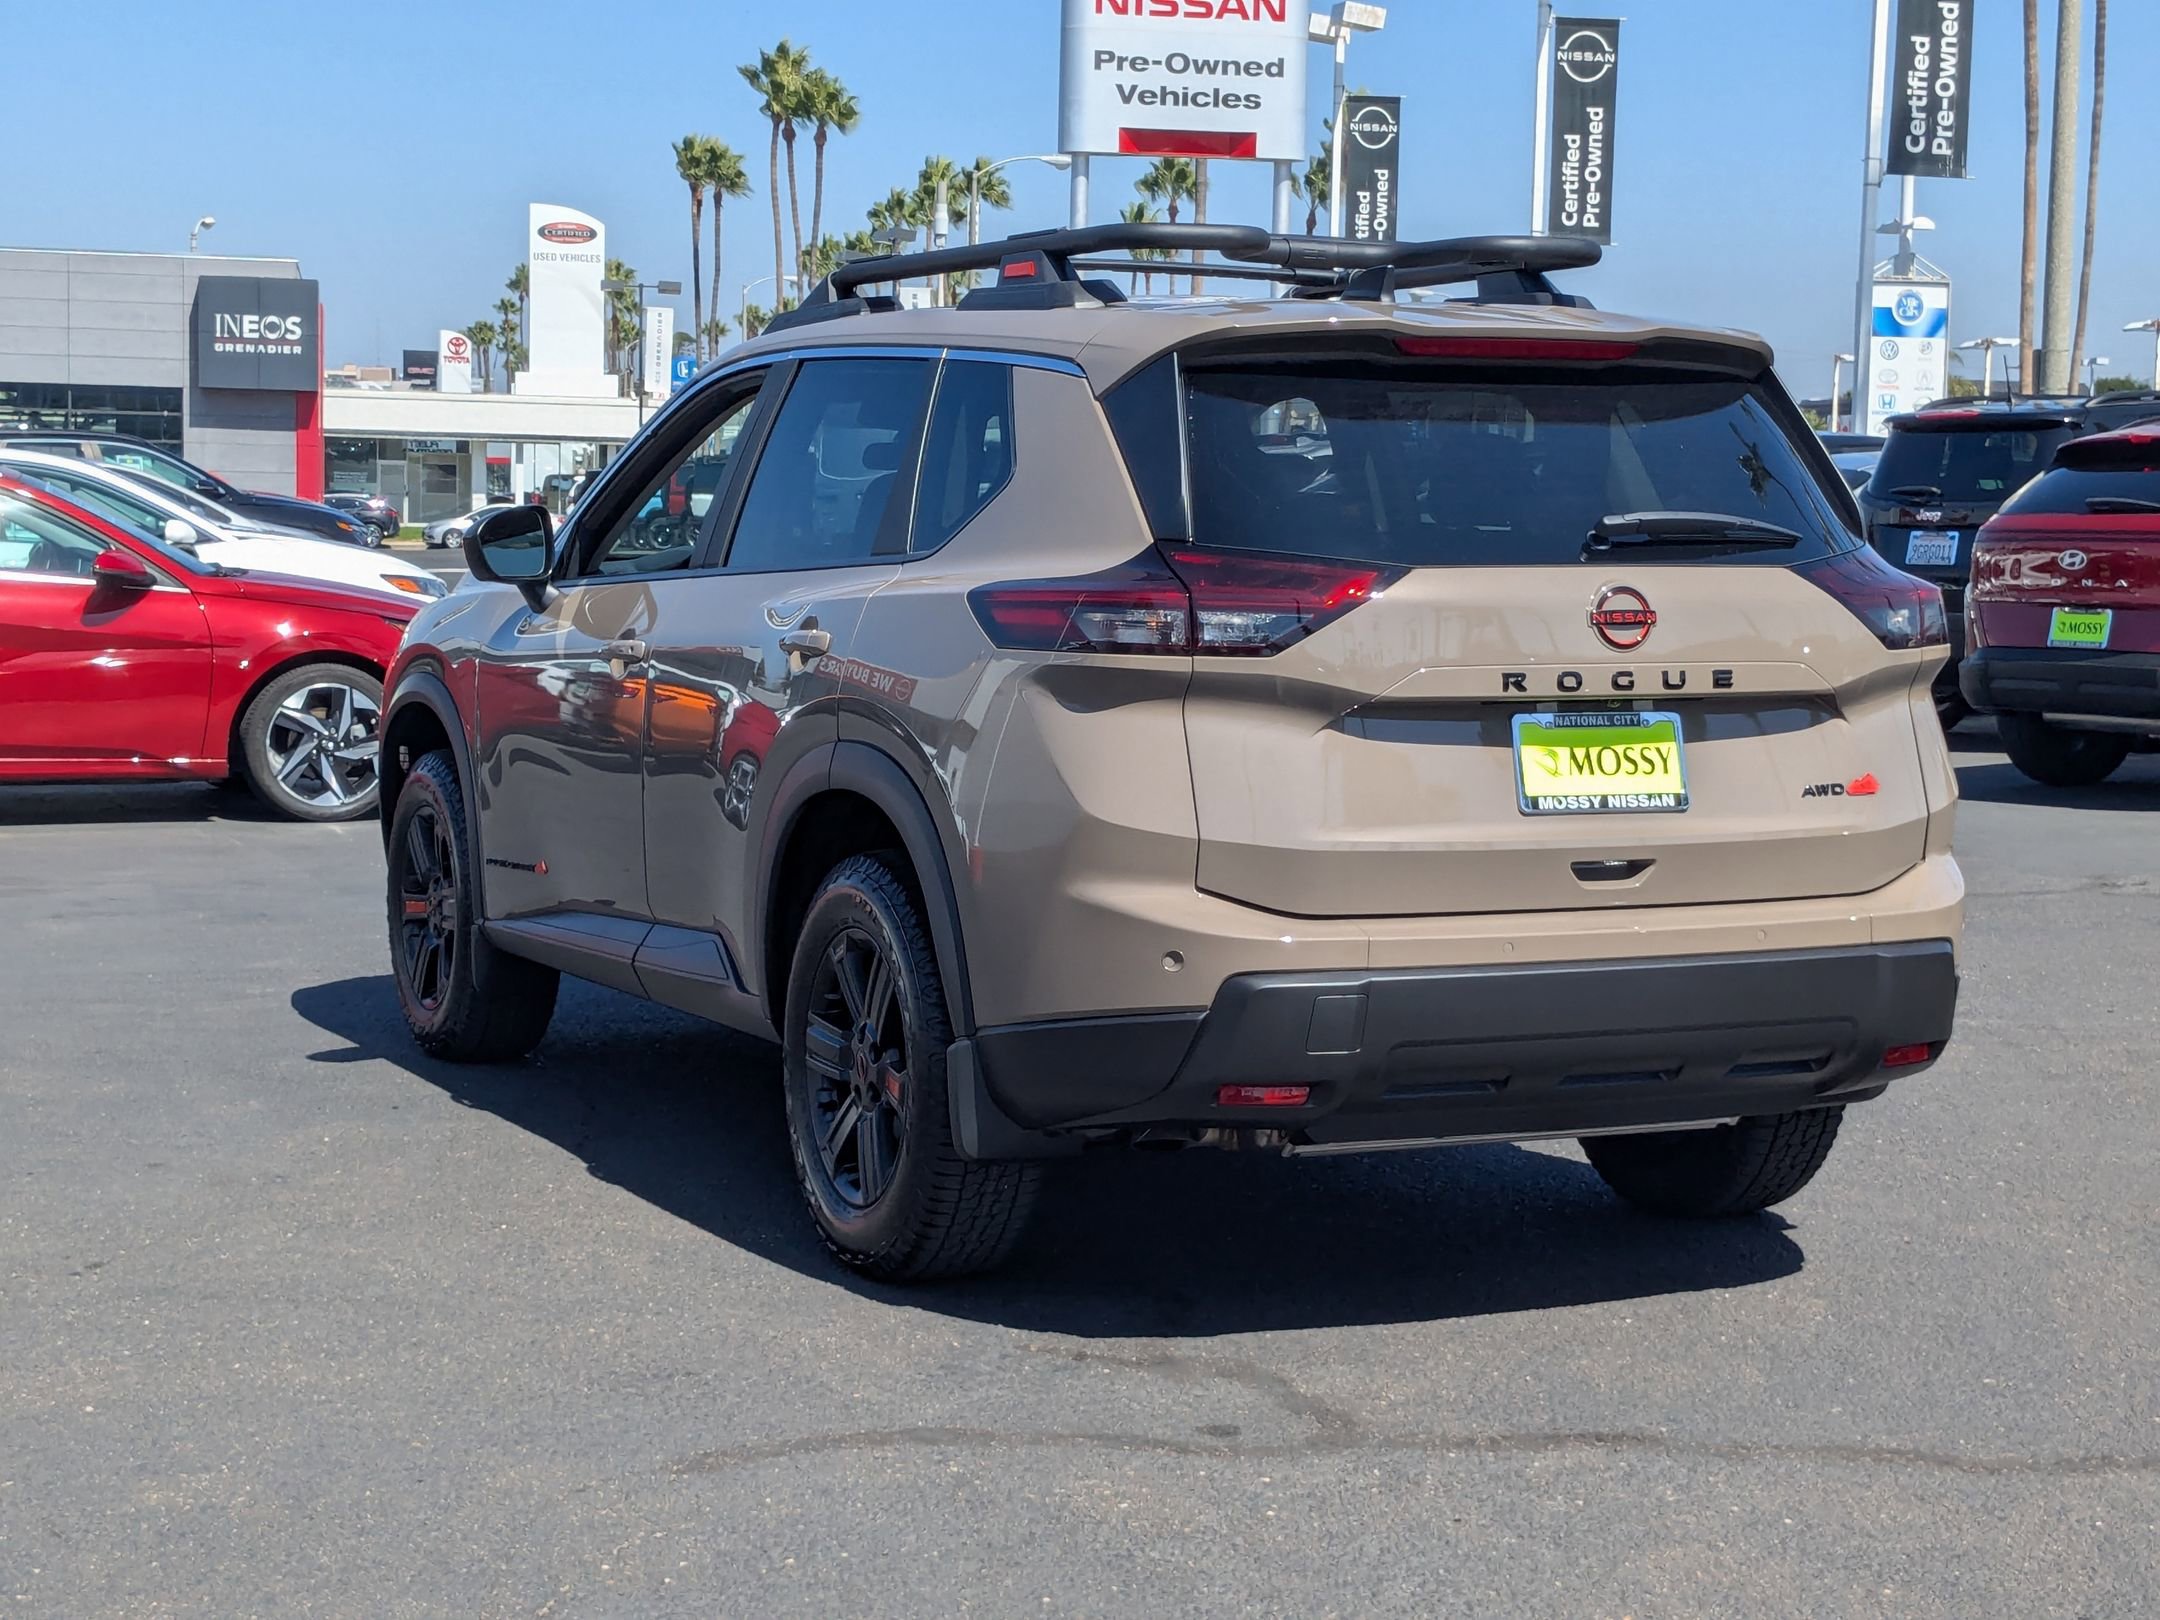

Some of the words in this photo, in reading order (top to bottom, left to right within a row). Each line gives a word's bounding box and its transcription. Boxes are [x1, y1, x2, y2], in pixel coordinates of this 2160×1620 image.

[1095, 0, 1286, 22] NISSAN
[1094, 50, 1285, 78] Pre-Owned
[1557, 51, 1615, 62] NISSAN
[1931, 1, 1960, 156] Pre-Owned
[1115, 83, 1262, 109] Vehicles
[1905, 35, 1931, 154] Certified
[1350, 122, 1397, 133] NISSAN
[1582, 106, 1604, 228] Pre-Owned
[1561, 133, 1581, 227] Certified
[1373, 168, 1389, 240] -Owned
[1355, 191, 1370, 239] tified
[533, 252, 557, 261] USED
[559, 253, 601, 263] VEHICLES
[214, 313, 302, 340] INEOS
[214, 343, 302, 354] GRENADIER
[443, 356, 470, 364] TOYOTA
[1916, 509, 1941, 522] Jeep
[2023, 579, 2128, 588] KONA
[1592, 612, 1657, 624] NISSAN
[2068, 622, 2106, 635] MOSSY
[1502, 669, 1734, 692] ROGUE
[1555, 716, 1610, 726] NATIONAL
[1613, 714, 1640, 725] CITY
[1569, 746, 1671, 776] MOSSY
[1801, 783, 1845, 798] AWD
[1538, 796, 1600, 810] MOSSY
[1608, 793, 1675, 807] NISSAN
